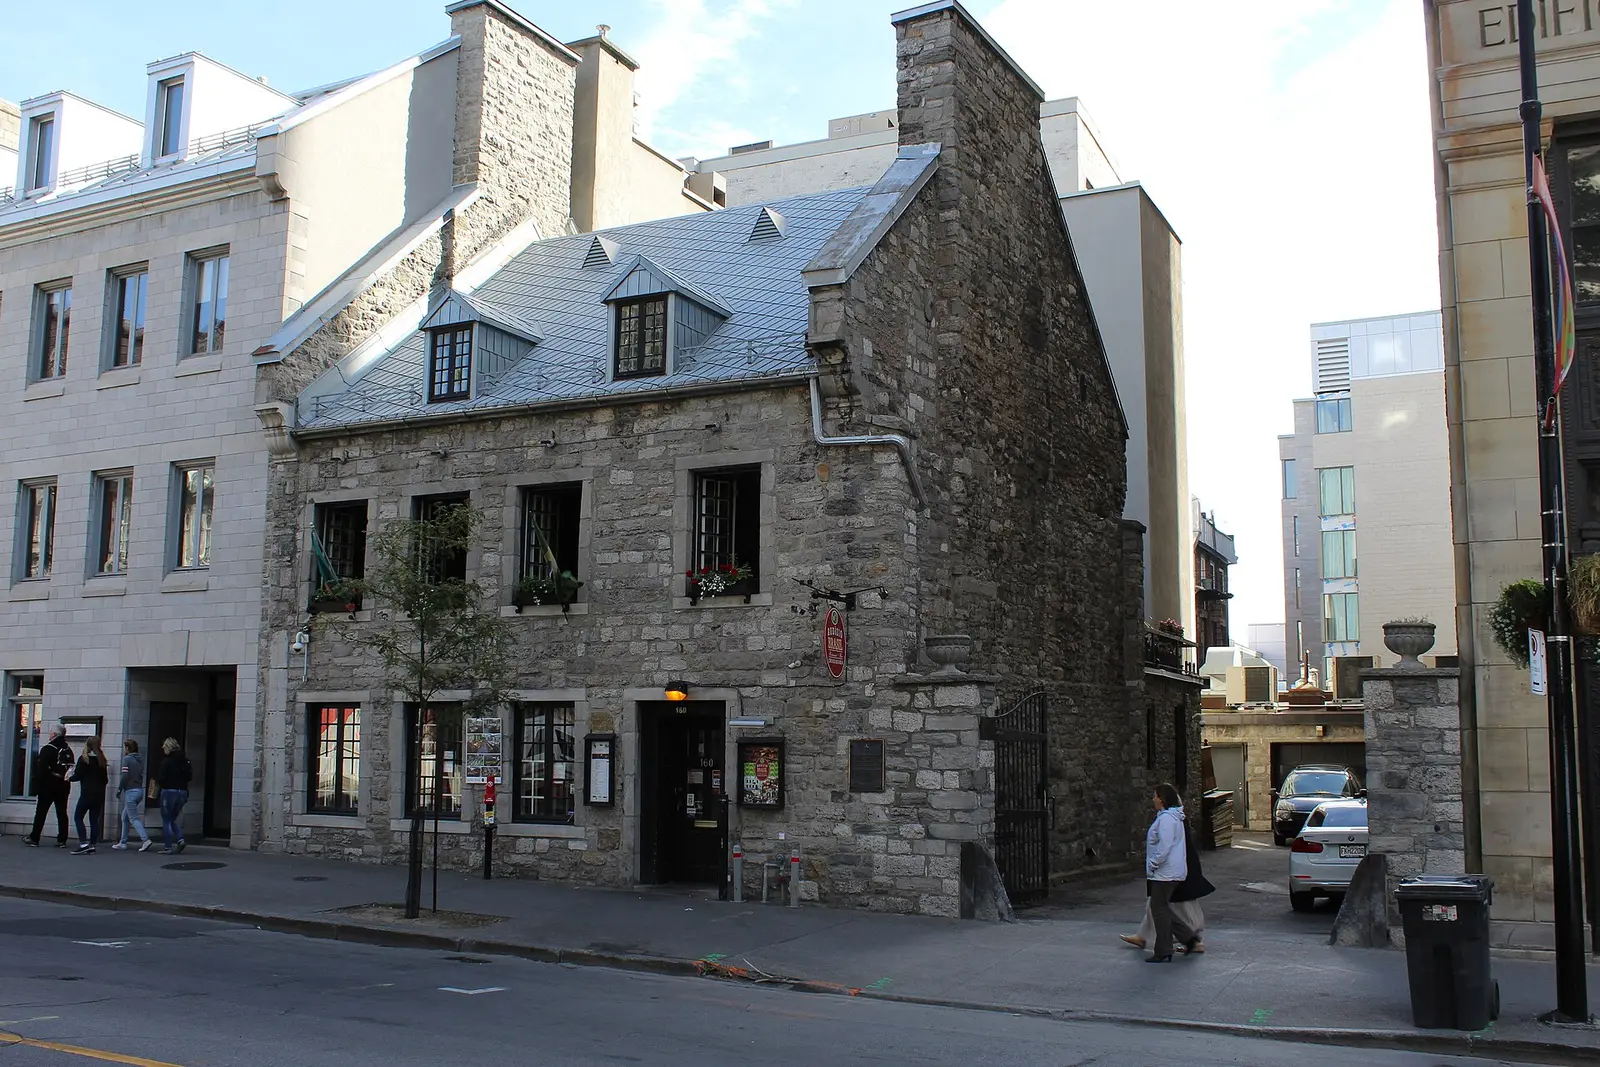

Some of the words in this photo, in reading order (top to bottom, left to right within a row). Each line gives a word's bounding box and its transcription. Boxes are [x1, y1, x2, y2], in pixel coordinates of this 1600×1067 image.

[1478, 0, 1600, 47] EDIFI
[675, 706, 687, 714] 160
[700, 758, 714, 768] 160
